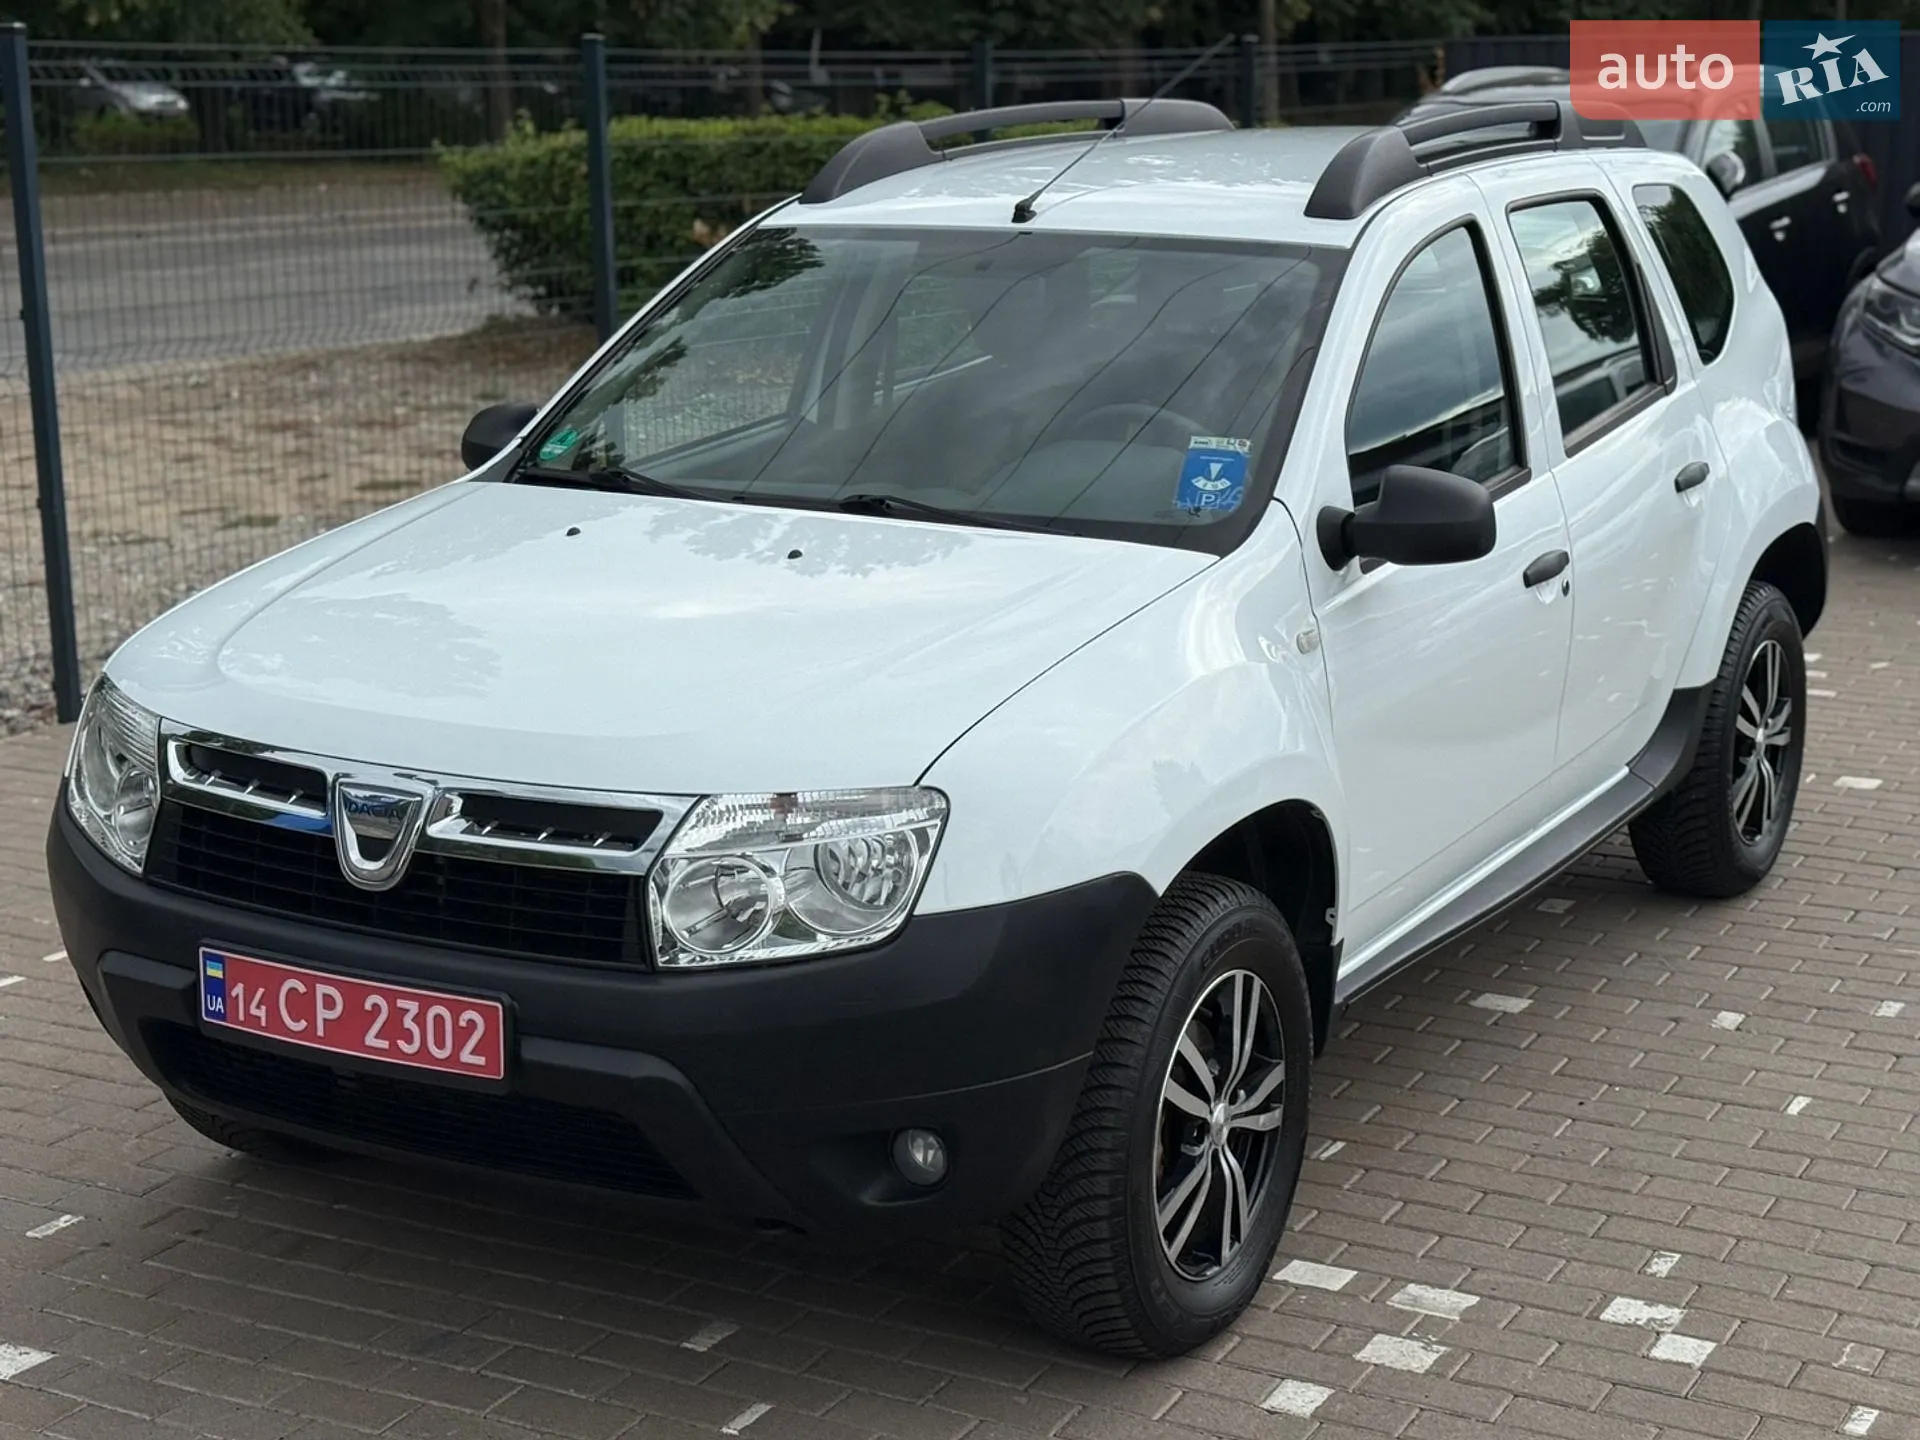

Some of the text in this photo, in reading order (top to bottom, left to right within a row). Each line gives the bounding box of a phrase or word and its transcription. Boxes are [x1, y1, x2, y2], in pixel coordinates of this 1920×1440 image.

[207, 993, 225, 1014] UA
[230, 978, 486, 1066] 14 CP 2302
